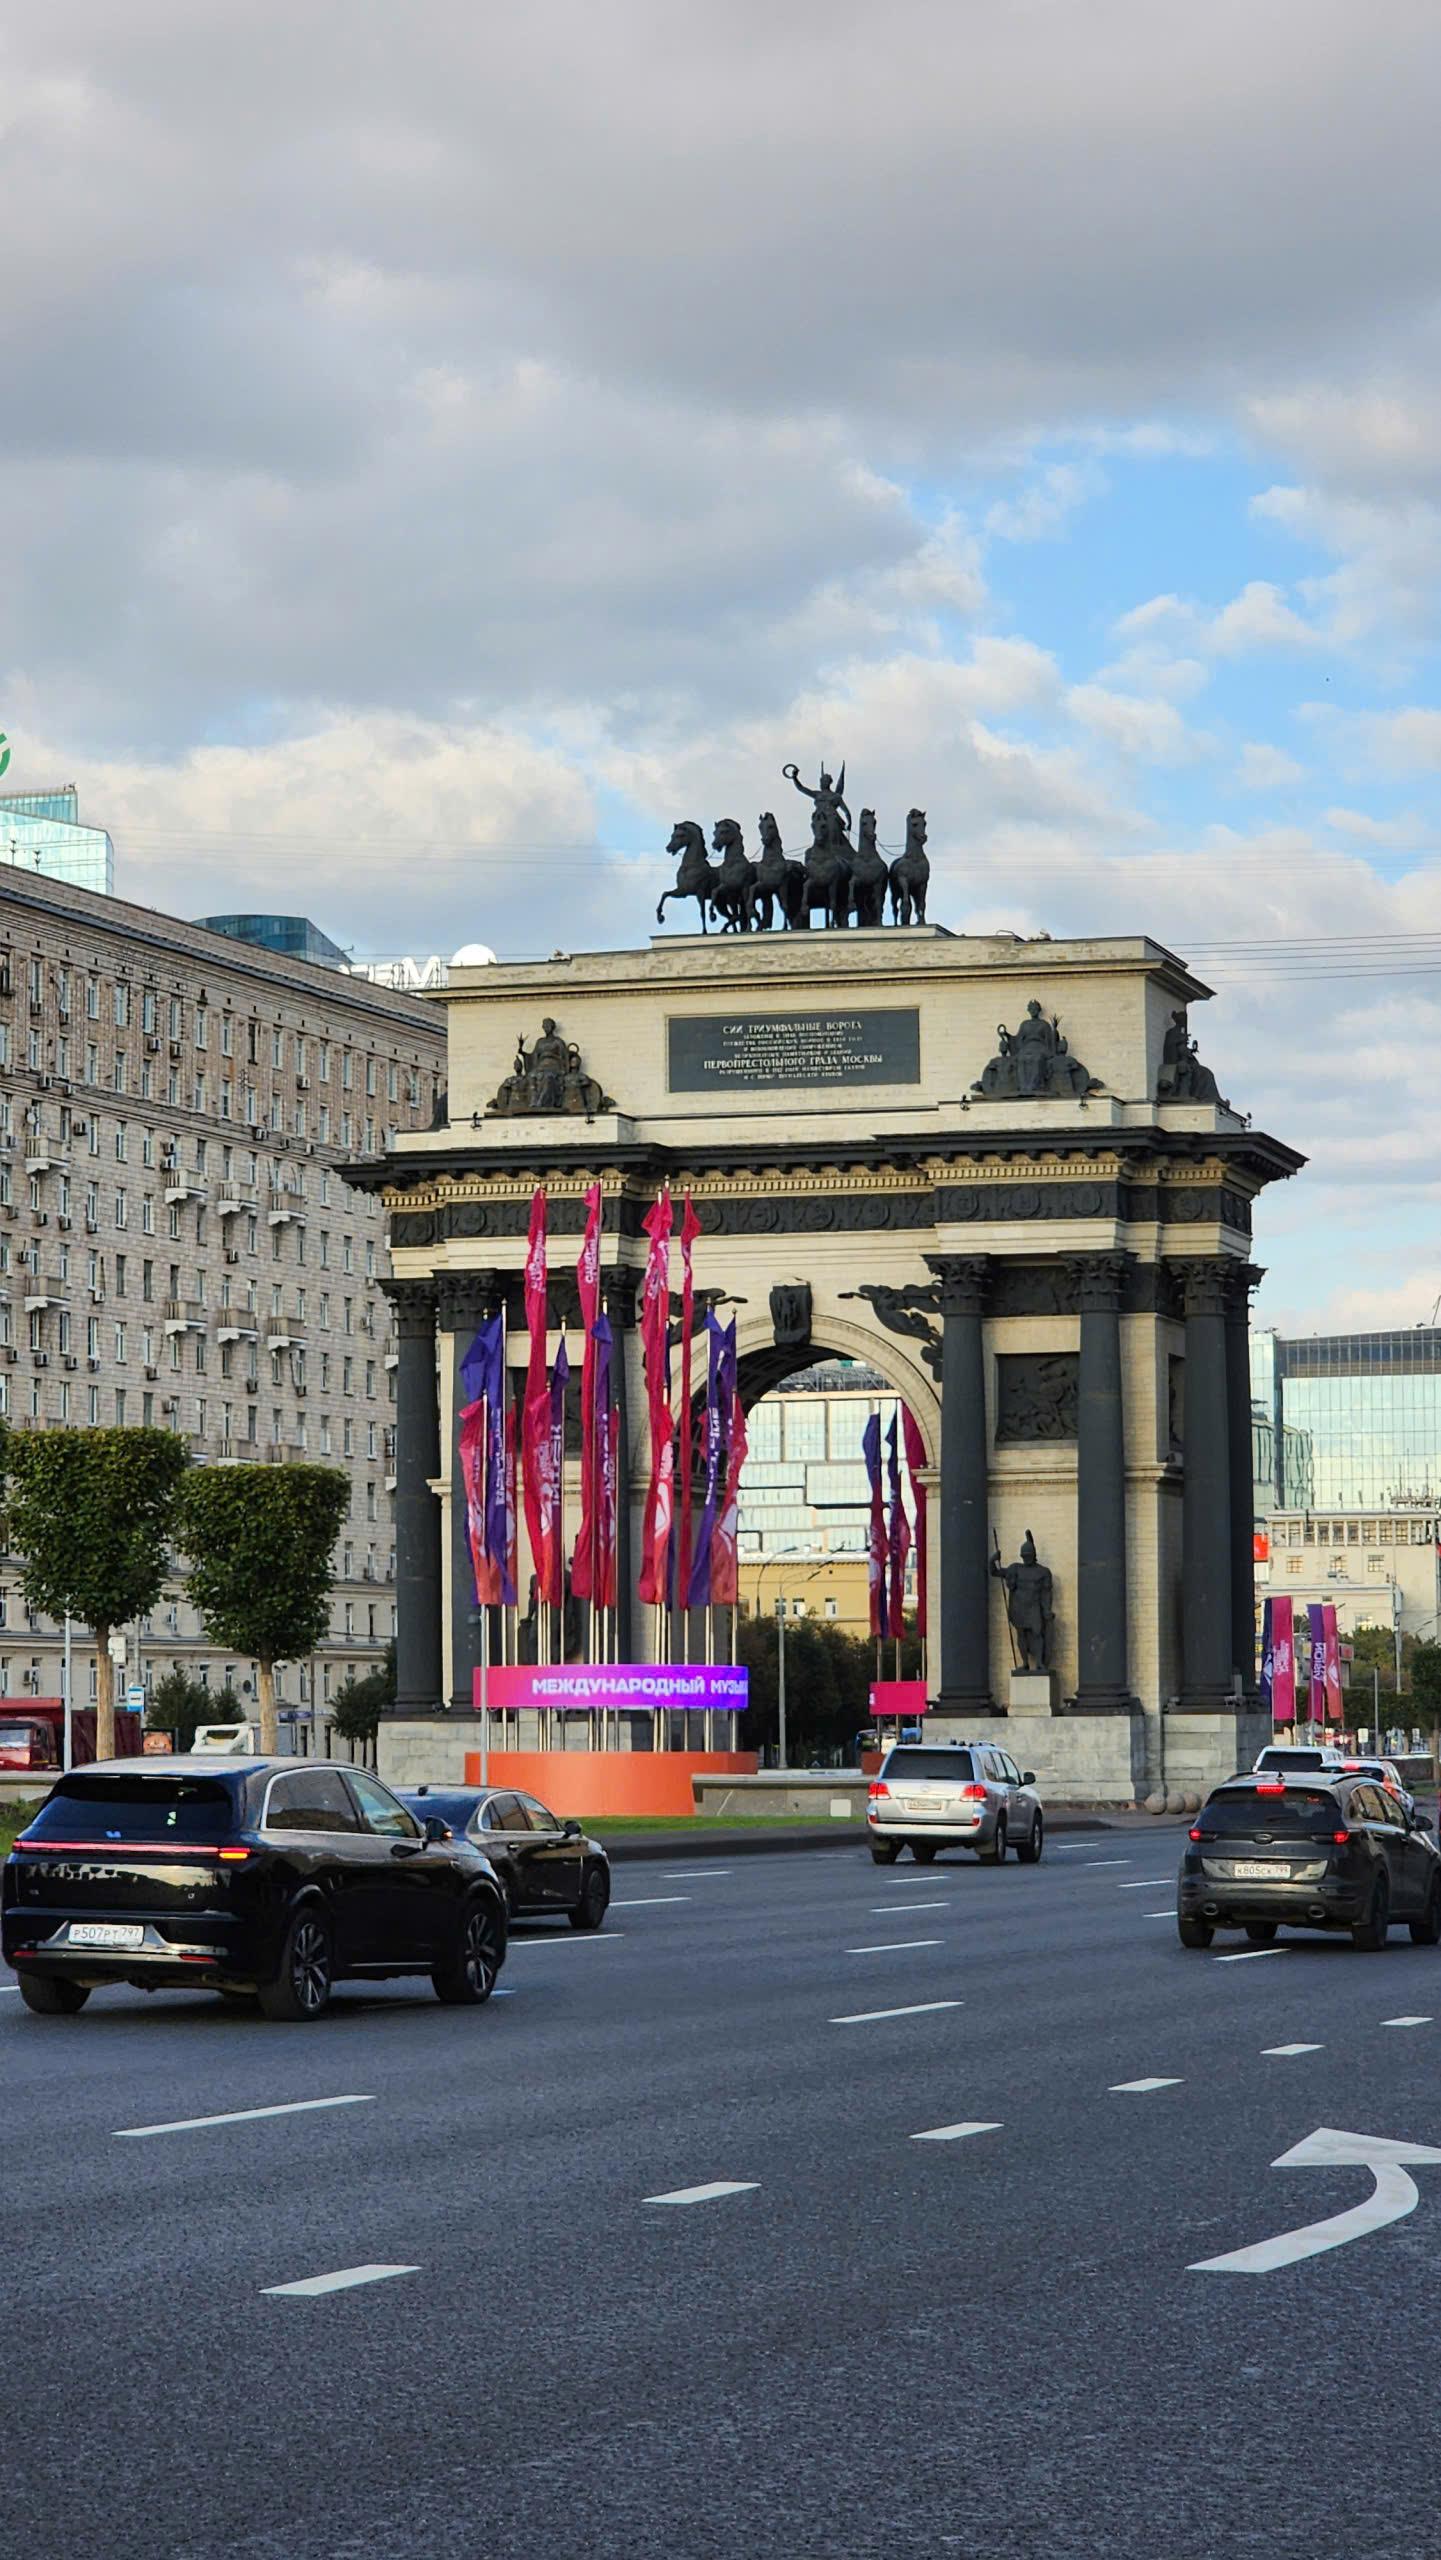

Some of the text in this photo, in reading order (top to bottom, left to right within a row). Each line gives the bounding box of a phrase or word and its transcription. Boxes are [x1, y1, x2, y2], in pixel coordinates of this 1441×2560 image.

[748, 1022, 821, 1034] ТРИУМФАЛЬНЫЕ
[826, 1020, 863, 1031] ВОРОТА
[703, 1057, 806, 1070] ПЕРВОПРЕСТОЛЬНОГО
[810, 1055, 838, 1066] ГРАДА
[841, 1054, 884, 1064] МОСКВЫ
[532, 1675, 748, 1695] МЕЖДУНАРОДНЫЙ МУЗЫ
